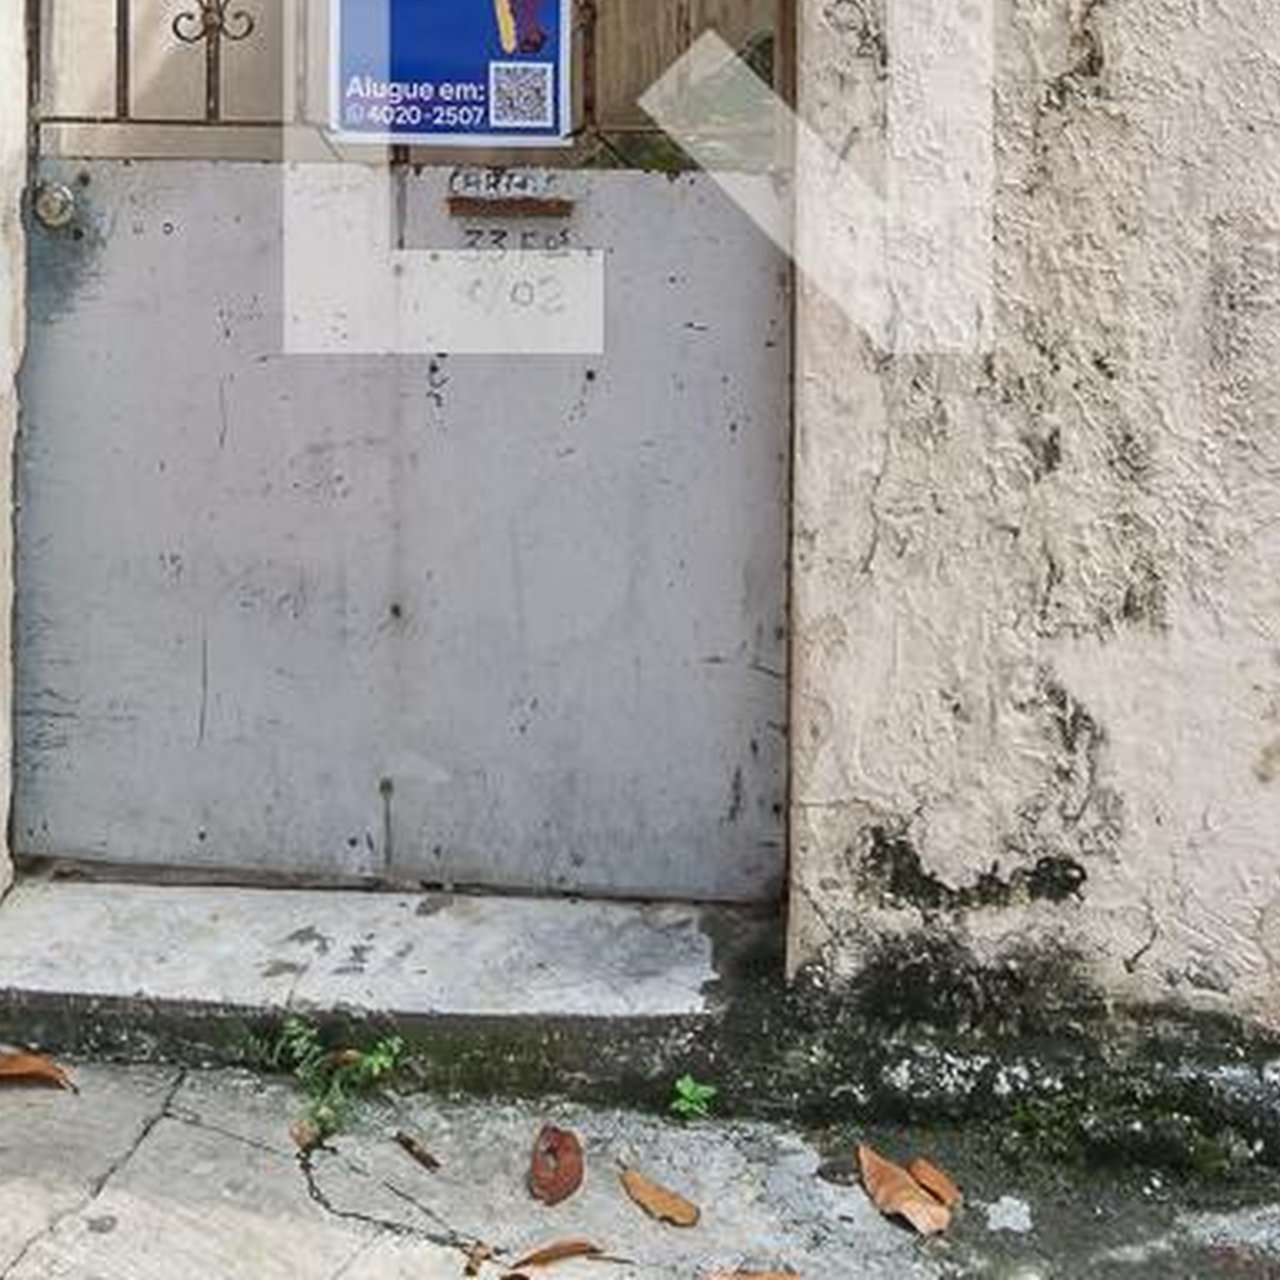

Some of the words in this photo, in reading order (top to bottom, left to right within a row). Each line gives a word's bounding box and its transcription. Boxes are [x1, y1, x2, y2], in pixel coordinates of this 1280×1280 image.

[345, 77, 434, 103] Alugue
[439, 80, 486, 102] em:
[368, 104, 485, 127] 4020-2507
